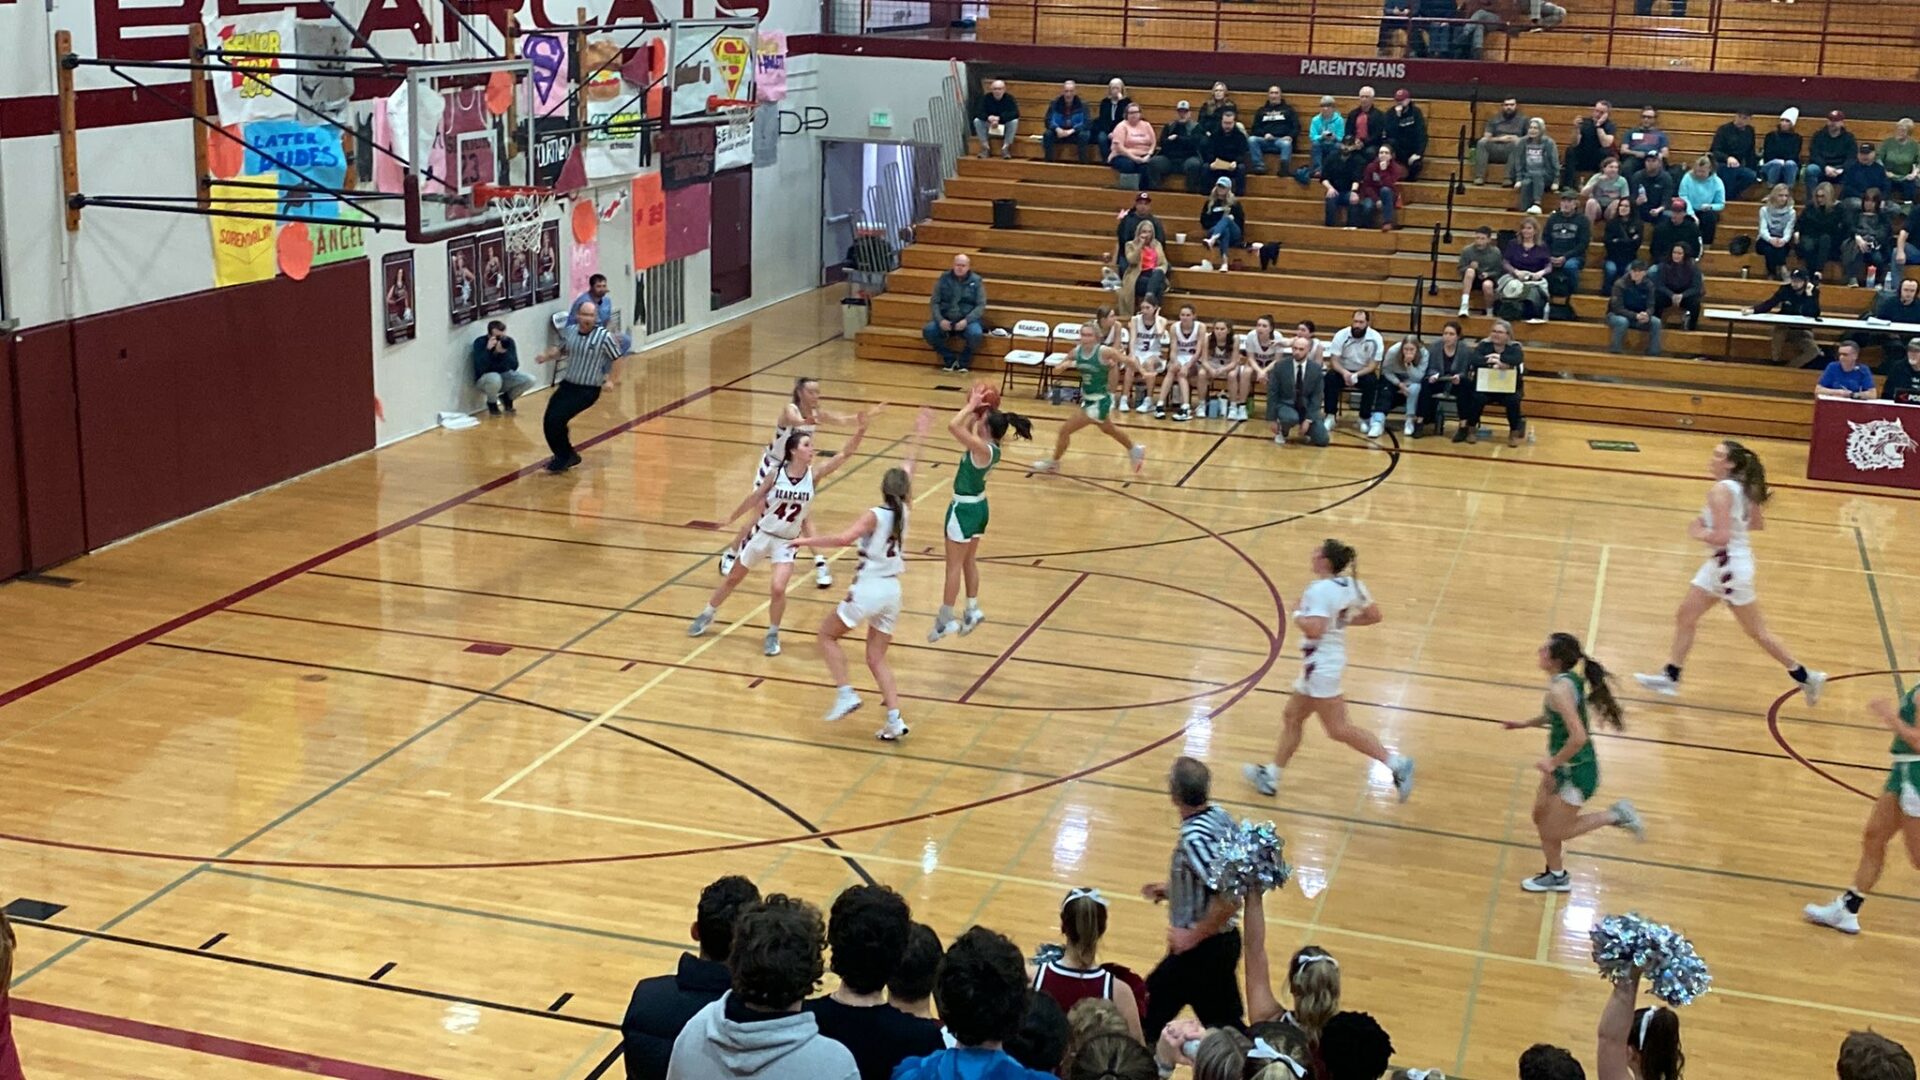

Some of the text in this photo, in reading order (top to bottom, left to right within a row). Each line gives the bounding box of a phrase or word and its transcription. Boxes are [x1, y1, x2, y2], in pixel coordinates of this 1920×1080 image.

[1300, 59, 1406, 79] PARENTS/FANS
[254, 132, 316, 149] LATER
[258, 146, 338, 173] DUDES
[317, 225, 365, 255] ANGEL
[1058, 327, 1082, 335] BEARCA
[775, 489, 809, 502] BEARCATS
[774, 502, 802, 523] 42
